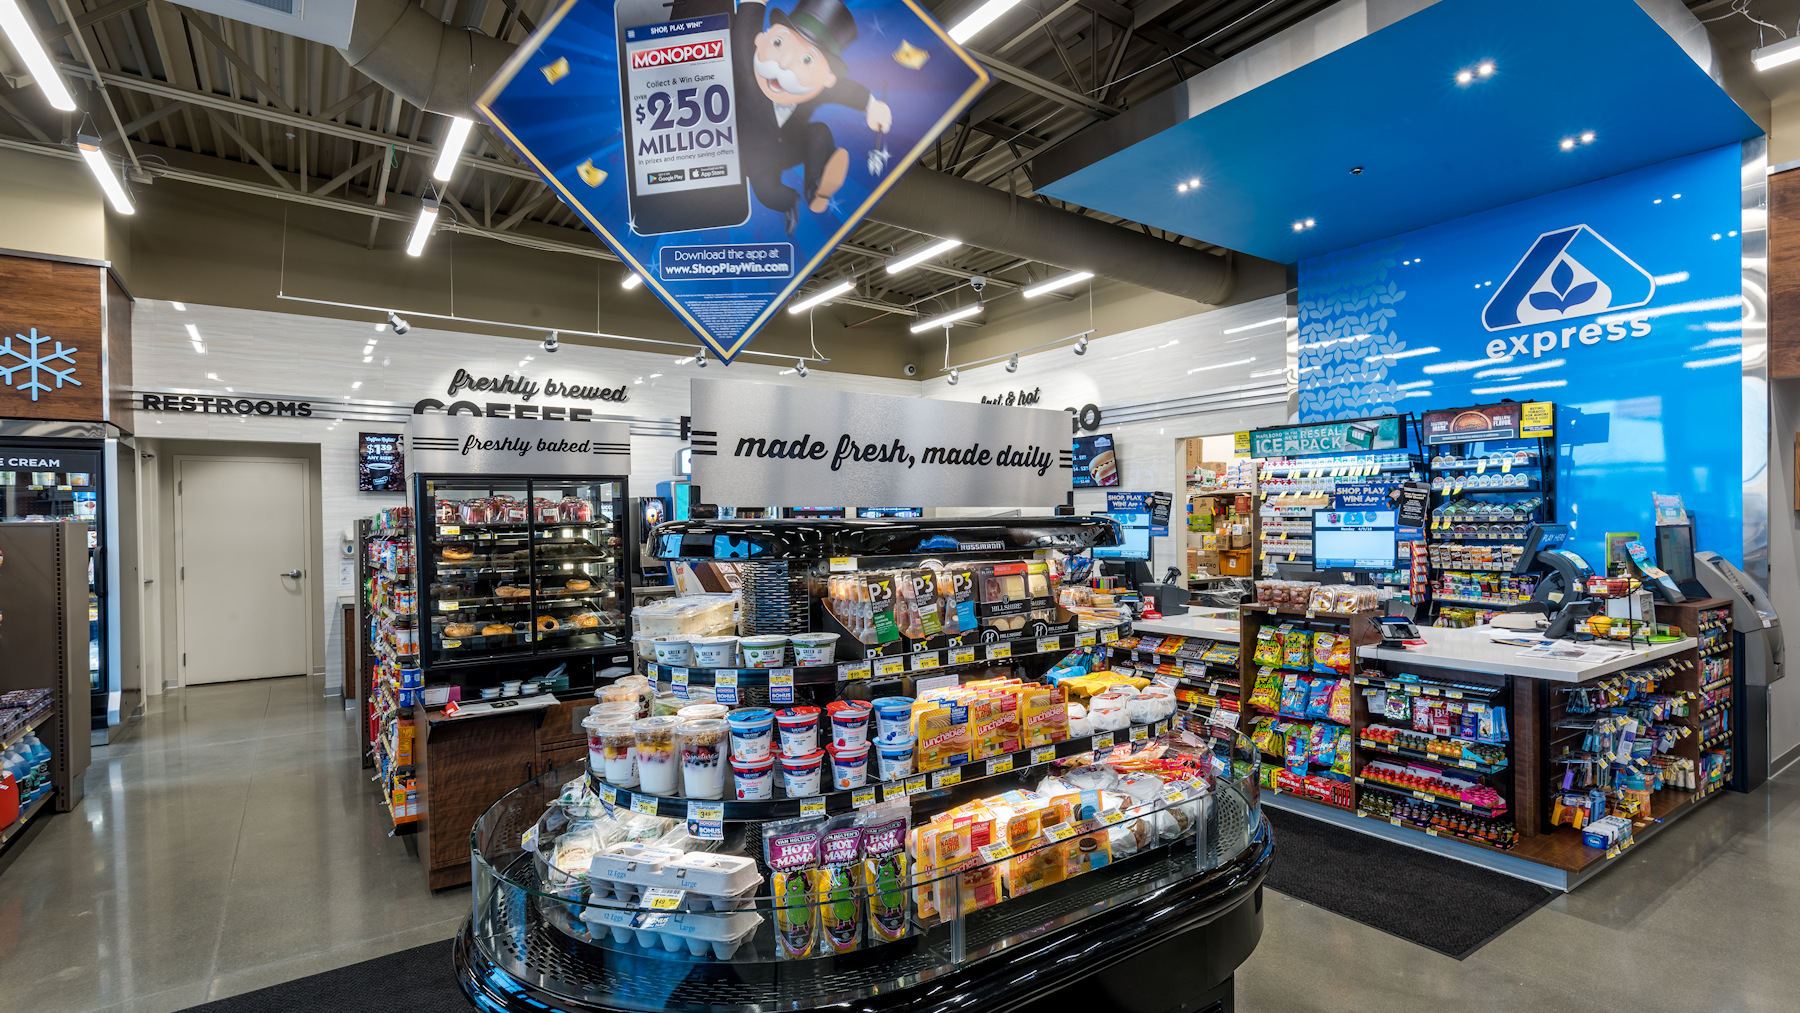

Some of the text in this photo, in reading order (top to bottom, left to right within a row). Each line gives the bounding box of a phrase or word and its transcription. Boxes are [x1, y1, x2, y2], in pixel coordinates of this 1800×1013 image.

[650, 25, 668, 35] SHOP,
[670, 23, 685, 33] PLAY,
[634, 42, 722, 68] MONOPOLY
[646, 80, 670, 88] Collect
[694, 74, 715, 82] Game
[638, 126, 733, 156] MILLION
[645, 158, 662, 166] prizes
[676, 154, 696, 162] money
[697, 151, 716, 160] saving
[717, 148, 734, 156] offers
[700, 170, 710, 178] App
[674, 248, 780, 261] Download the app at
[666, 262, 789, 276] www.ShopPlayWin.com
[1486, 314, 1652, 359] express
[447, 368, 628, 402] freshly brewed
[1005, 387, 1040, 406] & hot
[143, 394, 312, 417] RESTROOMS
[1300, 426, 1341, 439] RESEAL
[462, 434, 591, 456] freshly baked
[1256, 438, 1283, 454] ICE
[1300, 436, 1342, 450] PACK
[734, 433, 1054, 477] made fresh, made daily
[8, 457, 60, 468] CREAM
[1363, 487, 1385, 495] PLAY,
[1542, 533, 1566, 542] PLAY HERE
[960, 542, 1002, 550] HUSSMANN
[913, 574, 934, 596] P3
[953, 572, 972, 592] P3
[868, 580, 892, 602] P3
[991, 603, 1022, 612] HILLSHIRE
[1027, 705, 1064, 726] Lunchables
[977, 713, 1015, 735] Lunchables
[922, 726, 966, 749] Lunchables
[1277, 776, 1290, 784] Mike
[1305, 784, 1319, 792] Mike
[700, 811, 711, 819] 349
[789, 835, 815, 843] HOLTEN'S
[835, 831, 858, 839] HOLTEN'S
[870, 830, 896, 844] HOT
[941, 835, 959, 848] KABOB
[781, 843, 810, 856] HOT
[826, 839, 854, 852] HOT
[867, 839, 899, 853] MAMA
[776, 853, 813, 868] MAMA
[825, 850, 857, 863] MAMA
[992, 851, 1002, 859] 249
[614, 870, 626, 879] Eggs
[681, 880, 697, 888] Large
[655, 899, 666, 907] 149
[611, 914, 623, 922] Eggs
[679, 924, 696, 932] Large
